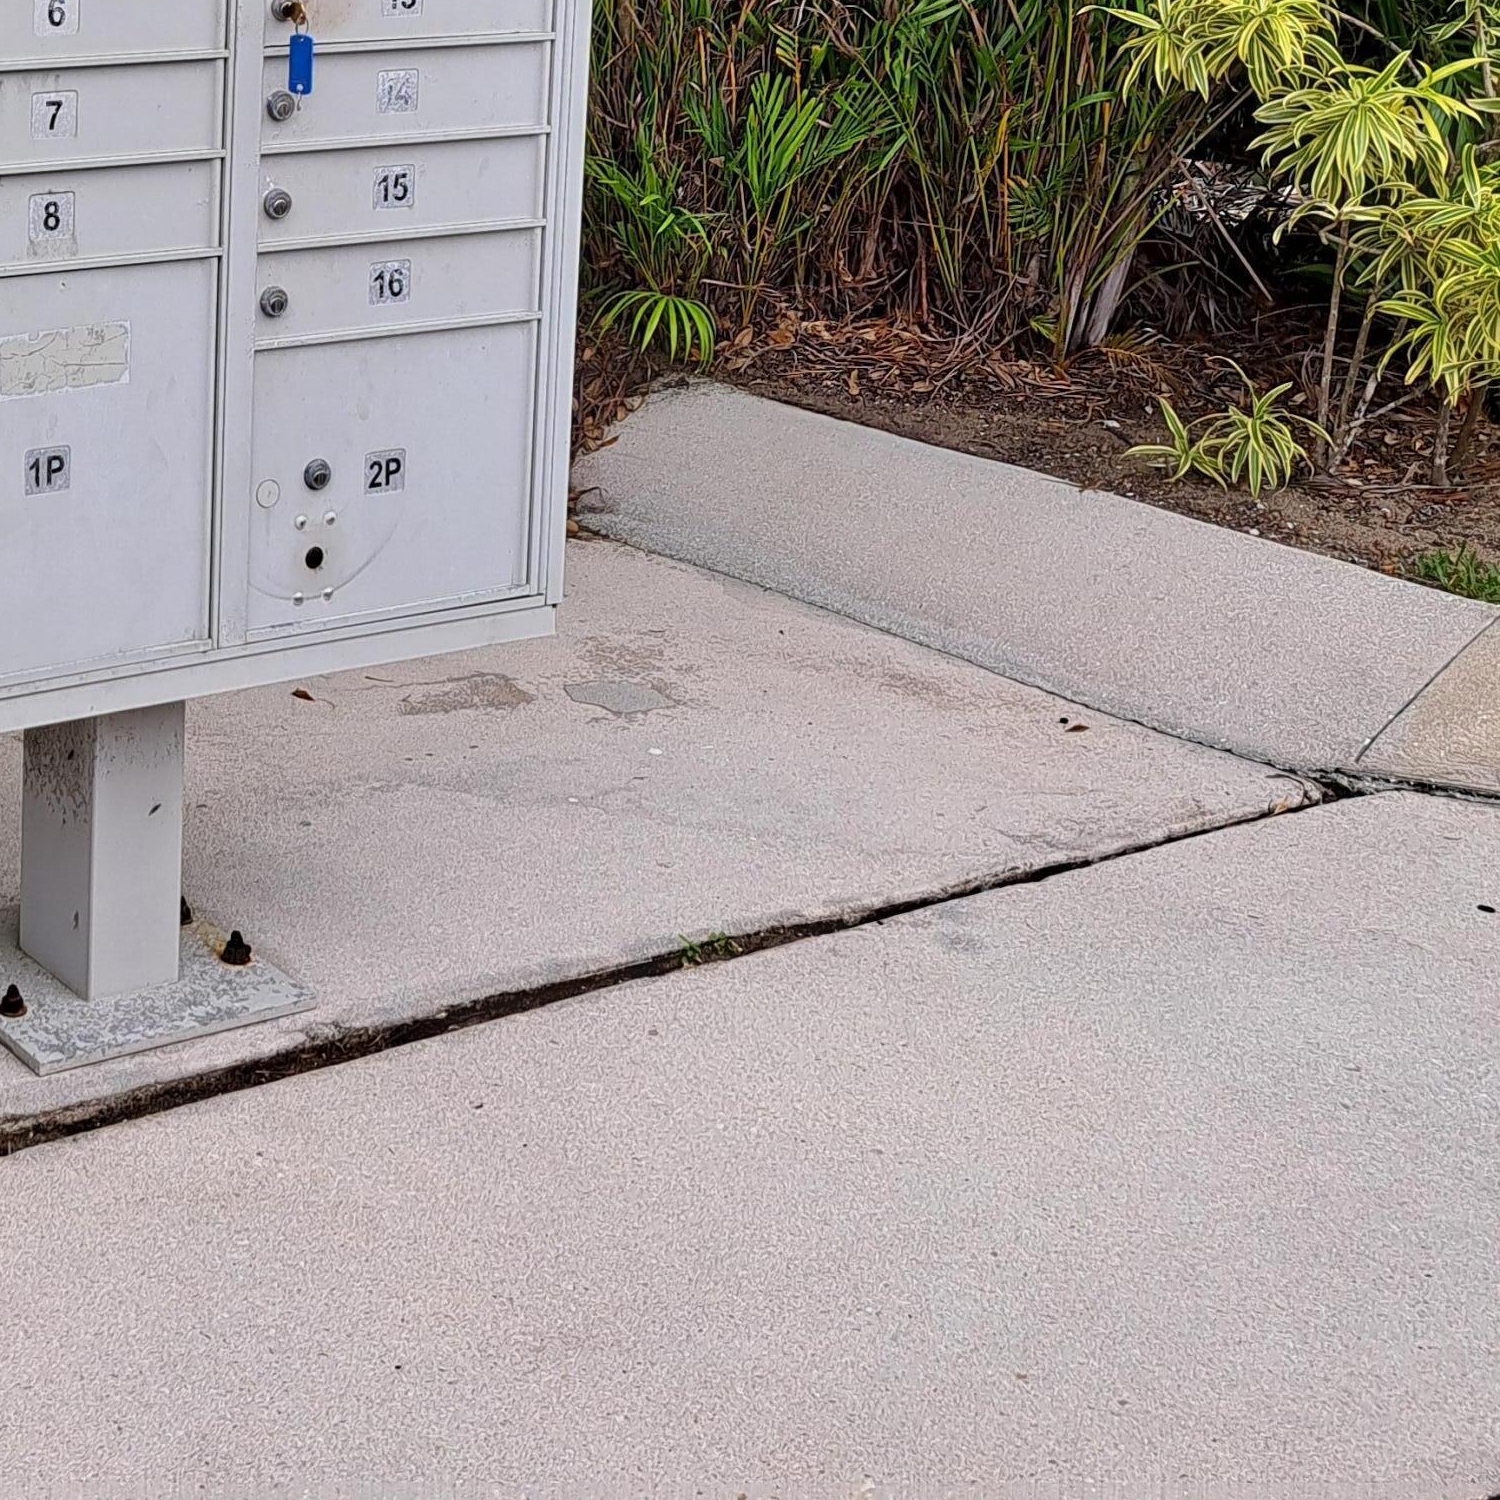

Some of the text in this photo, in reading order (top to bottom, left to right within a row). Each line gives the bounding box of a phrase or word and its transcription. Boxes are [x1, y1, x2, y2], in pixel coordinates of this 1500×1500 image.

[45, 100, 64, 131] 7
[378, 172, 408, 202] 15
[43, 200, 61, 232] 8
[373, 268, 404, 299] 16
[28, 454, 66, 488] 1P
[367, 457, 402, 489] 2P
